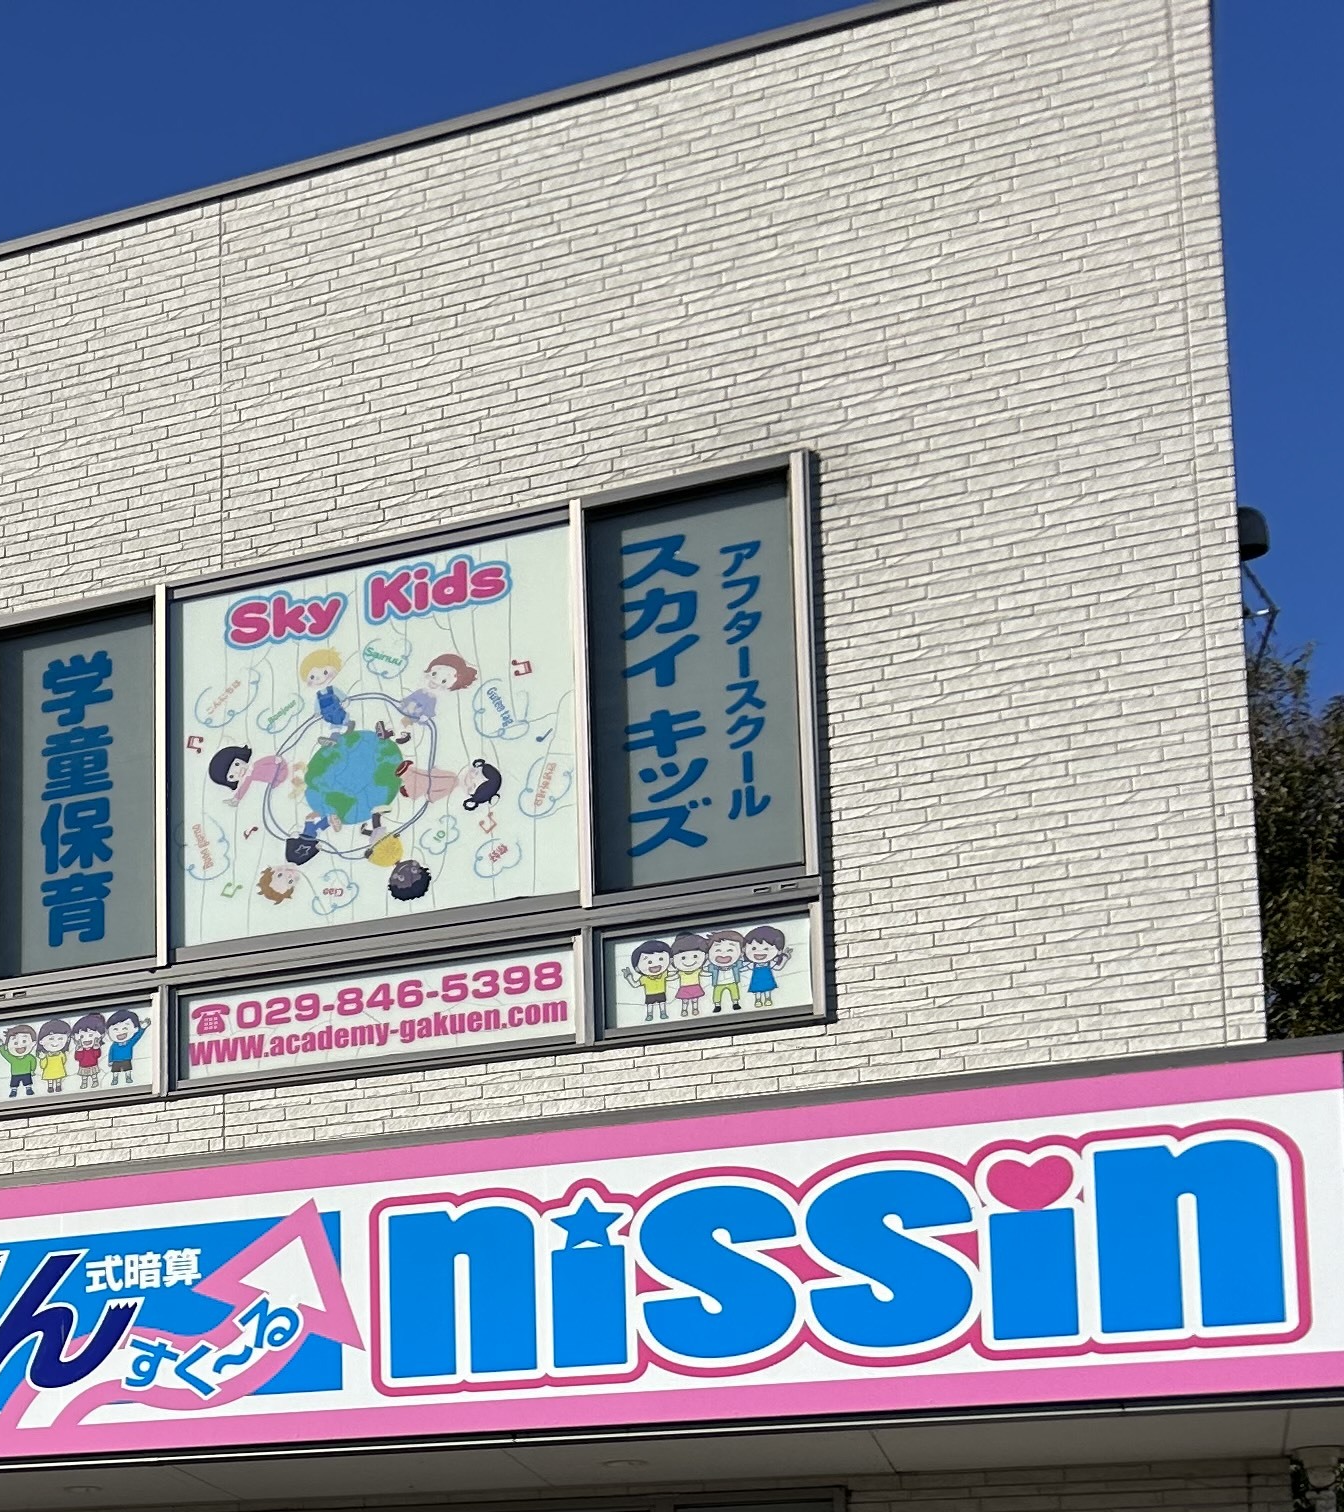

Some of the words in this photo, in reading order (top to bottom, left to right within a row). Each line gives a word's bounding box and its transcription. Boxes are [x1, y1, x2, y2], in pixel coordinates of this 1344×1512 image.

[228, 595, 343, 646] Sky
[368, 559, 508, 621] Kids
[719, 540, 771, 821] アフタースクール
[40, 650, 114, 948] 学童保育
[236, 961, 564, 1030] 029-846-5398
[84, 1247, 202, 1293] 式暗算
[387, 1137, 1288, 1380] nissin
